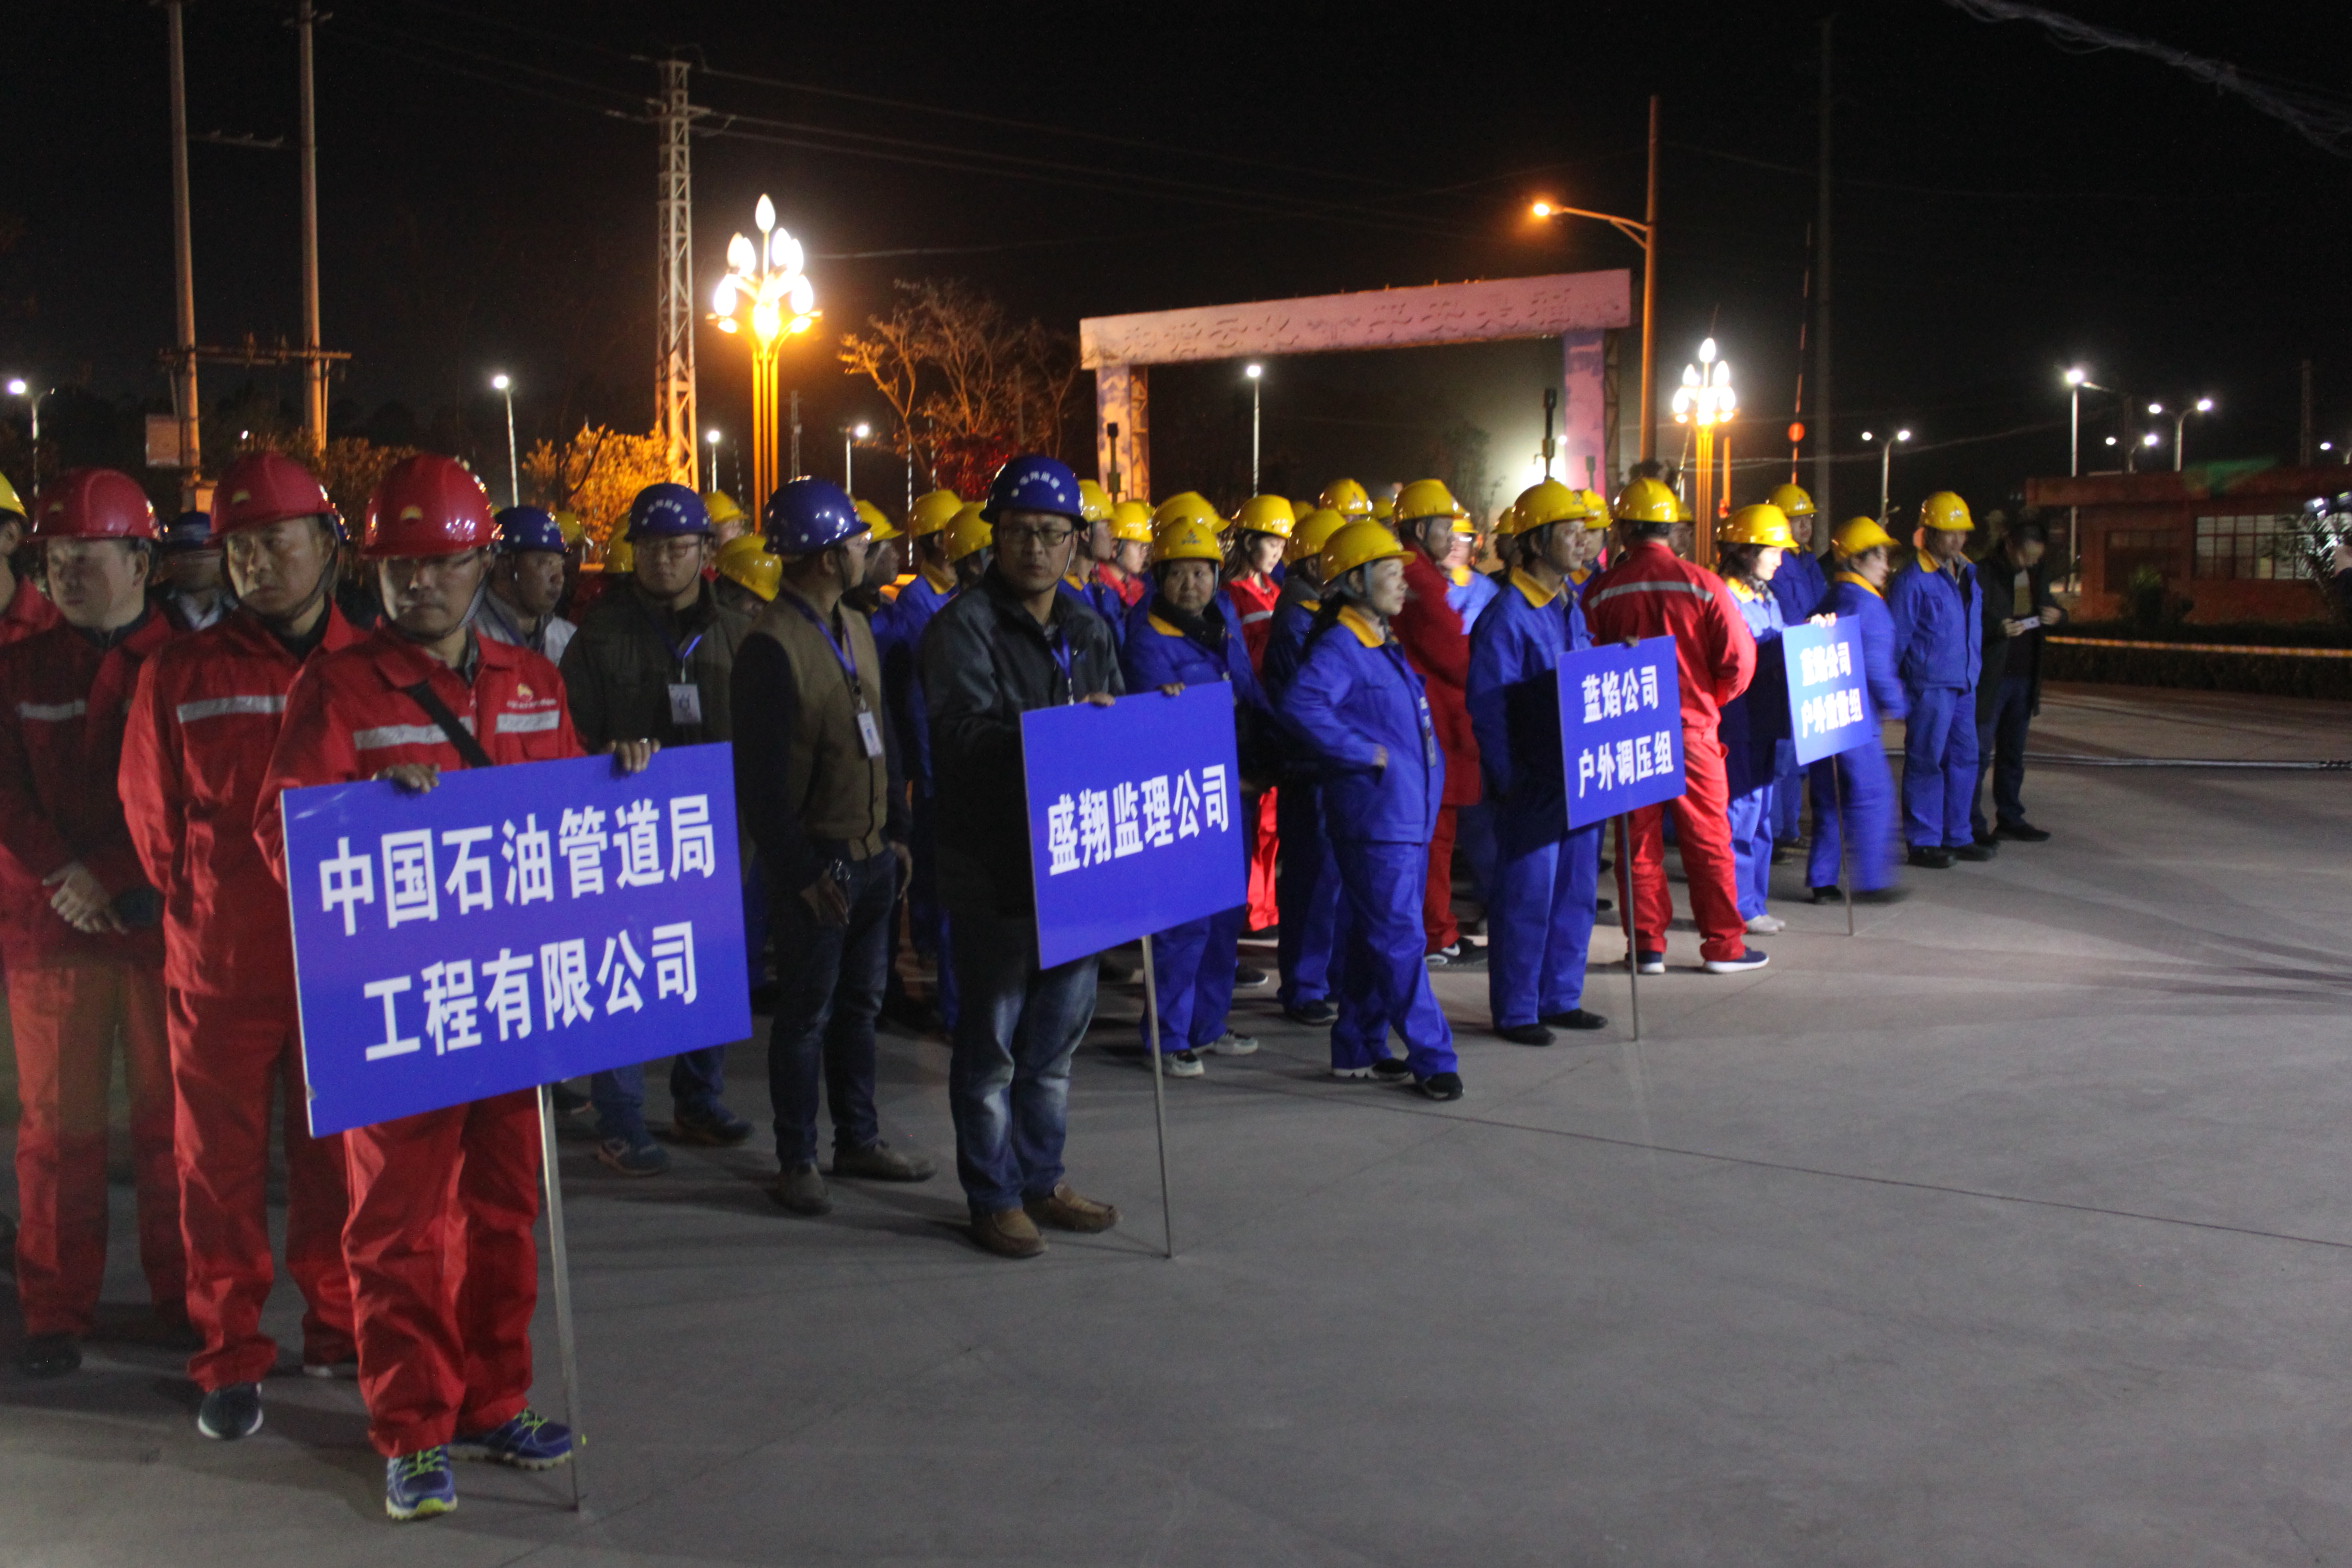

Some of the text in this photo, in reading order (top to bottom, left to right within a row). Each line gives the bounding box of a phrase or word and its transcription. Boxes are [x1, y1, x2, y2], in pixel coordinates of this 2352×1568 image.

[1581, 665, 1659, 724] 蓝焰公司
[1047, 763, 1229, 876] 盛翔监理公司
[1578, 730, 1674, 799] 户外调压组
[319, 794, 715, 936] 中国石油管道局
[363, 920, 698, 1061] 工程有限公司
